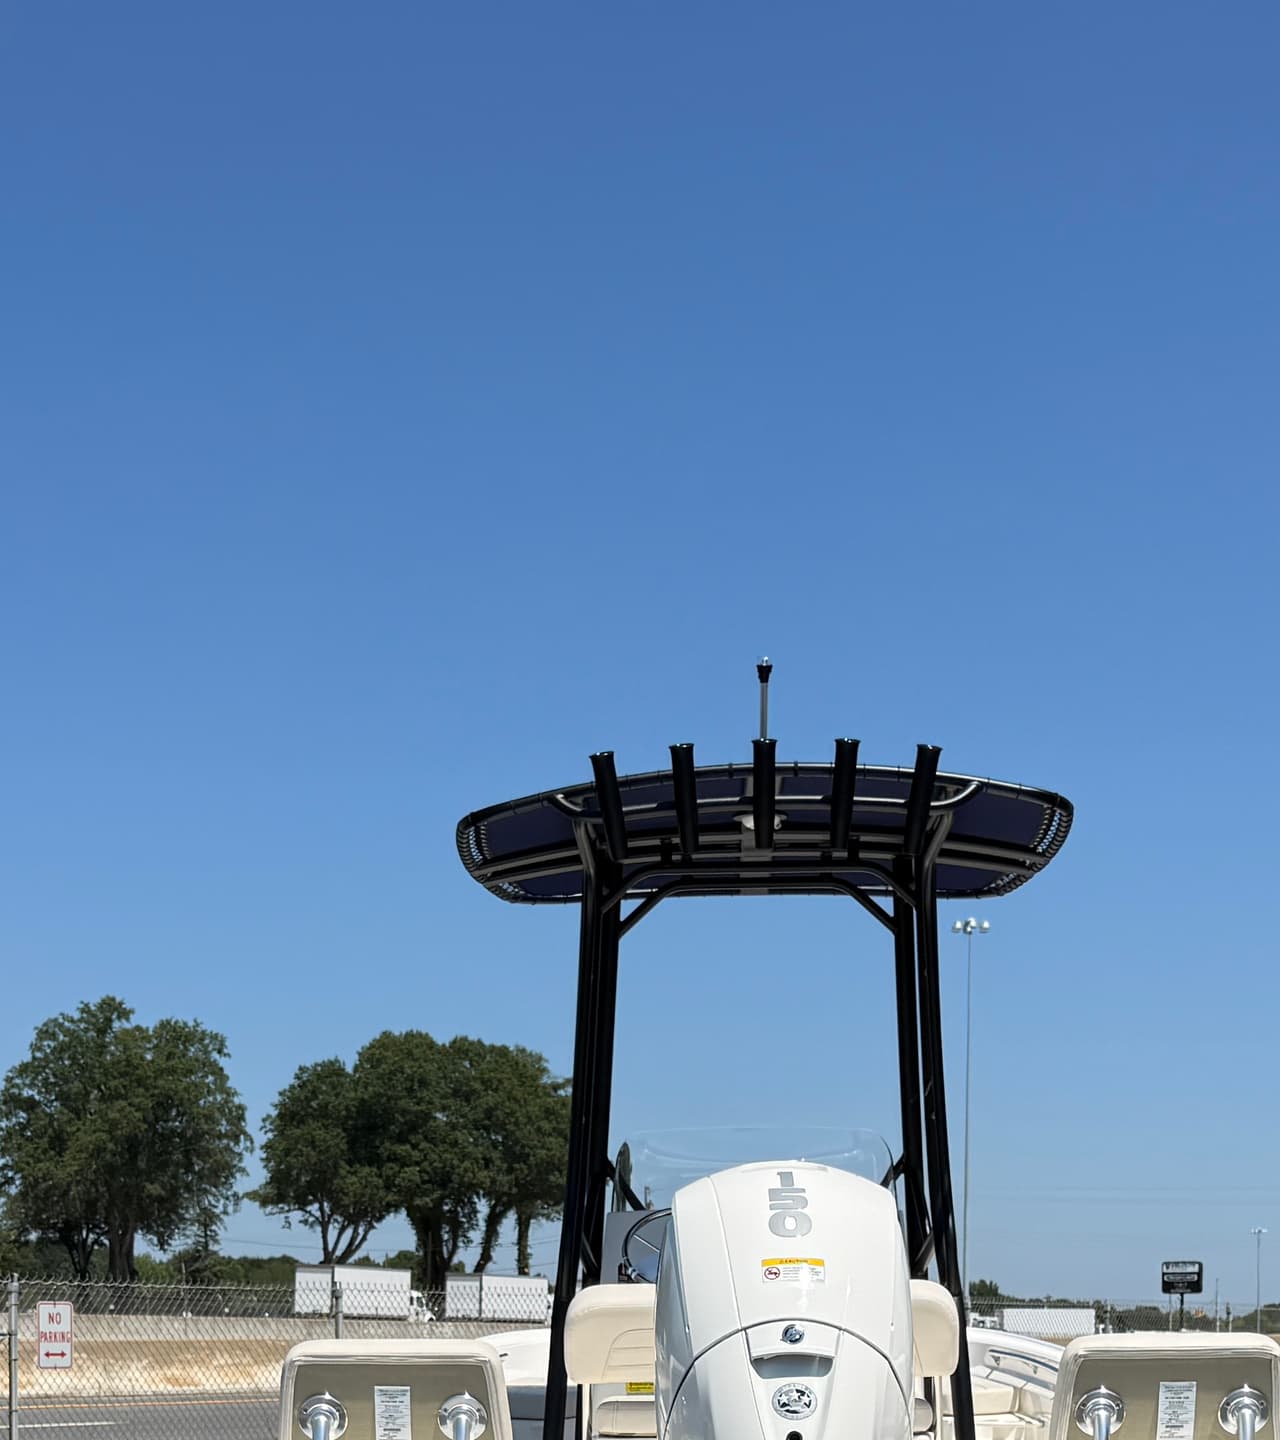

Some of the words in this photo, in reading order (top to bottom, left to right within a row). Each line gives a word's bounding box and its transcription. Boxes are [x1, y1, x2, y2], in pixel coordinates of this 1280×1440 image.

[767, 1171, 812, 1238] 150
[48, 1311, 62, 1326] NO
[40, 1330, 72, 1343] PARKING
